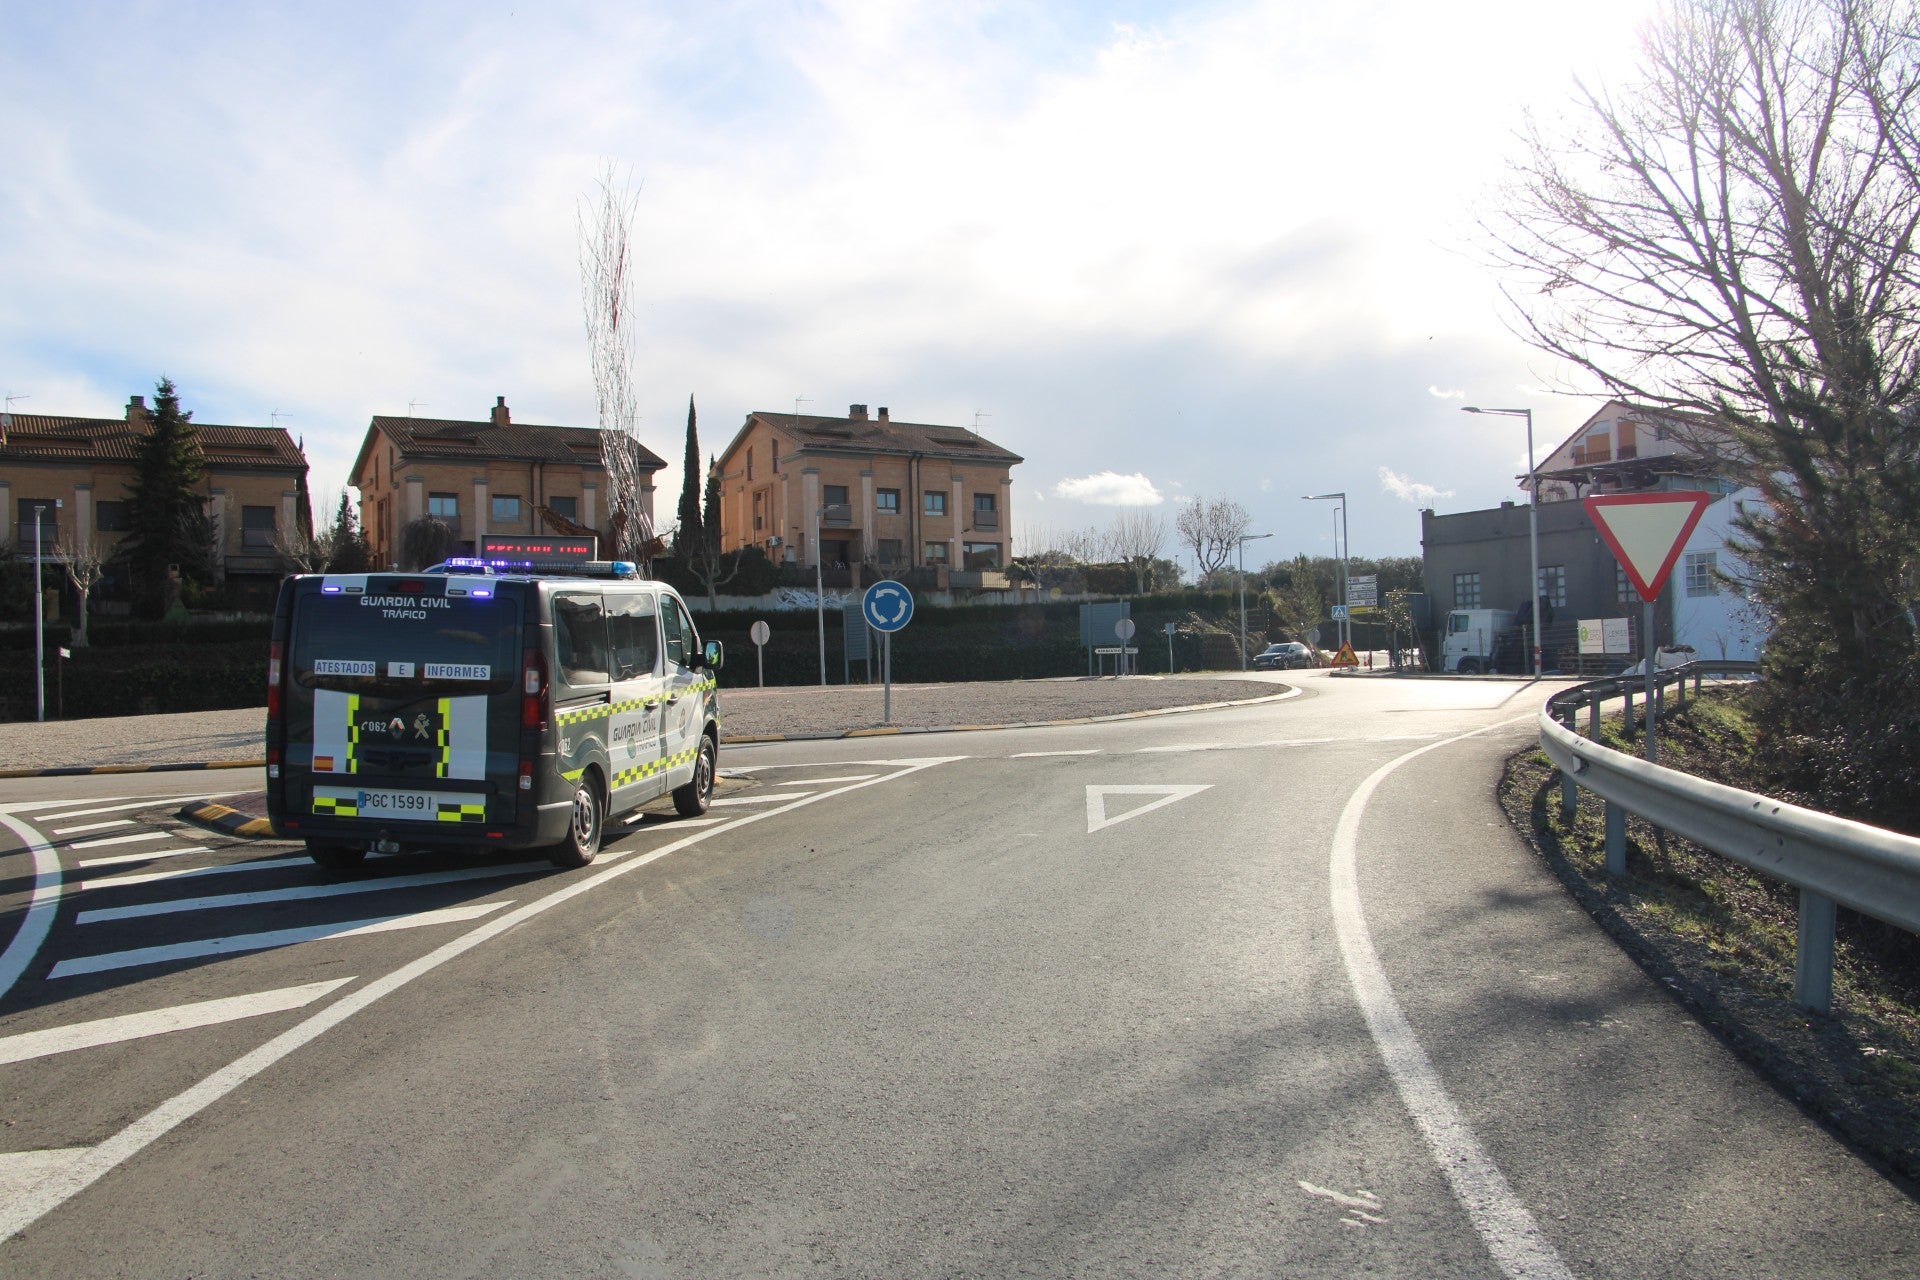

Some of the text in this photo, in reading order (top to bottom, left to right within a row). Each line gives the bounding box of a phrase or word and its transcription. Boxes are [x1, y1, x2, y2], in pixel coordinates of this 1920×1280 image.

[360, 596, 451, 609] GUARDIA CIVIL
[382, 608, 426, 619] TRÁFICO
[315, 661, 488, 679] ATESTADOS E INFORMES
[368, 721, 387, 733] 062
[613, 721, 641, 742] GUARDIA
